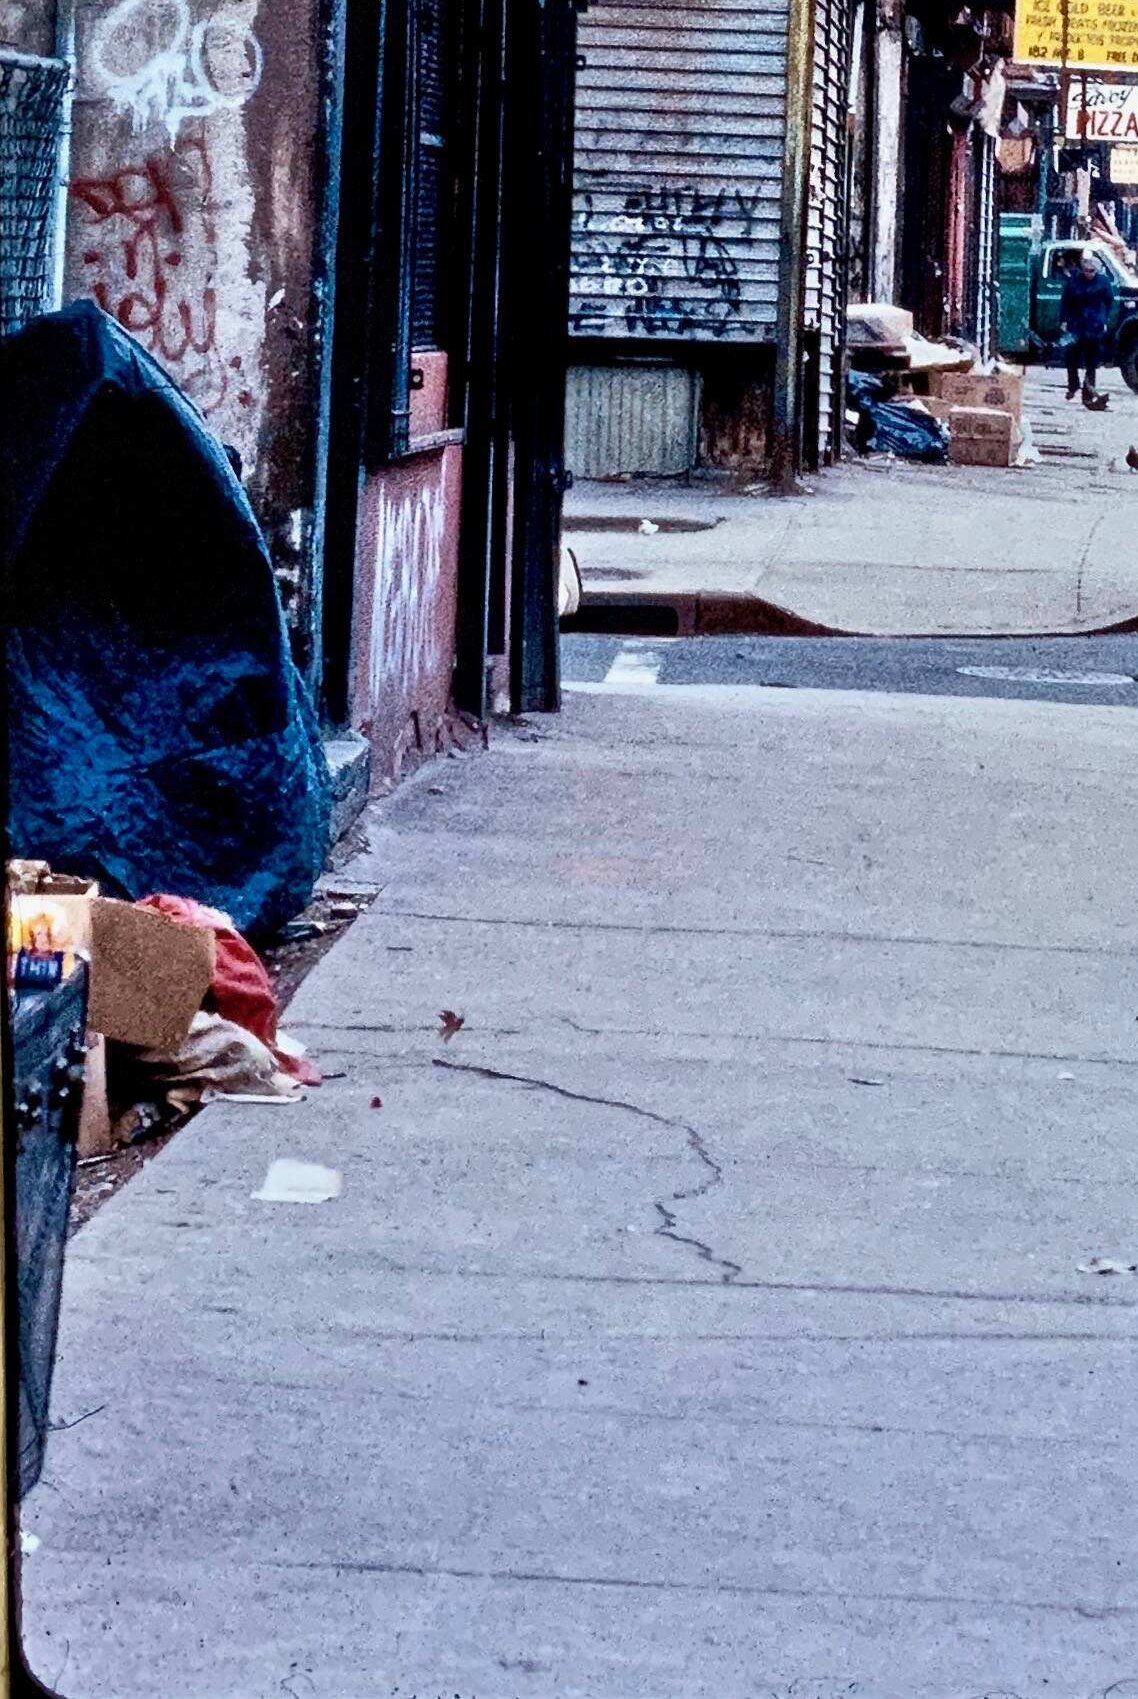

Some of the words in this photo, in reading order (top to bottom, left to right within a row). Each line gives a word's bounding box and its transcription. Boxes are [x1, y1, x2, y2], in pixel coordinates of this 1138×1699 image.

[1098, 3, 1126, 17] BEER
[1065, 16, 1098, 31] EATS
[1028, 46, 1048, 58] 182
[1077, 48, 1085, 61] B
[1106, 50, 1127, 63] FREE
